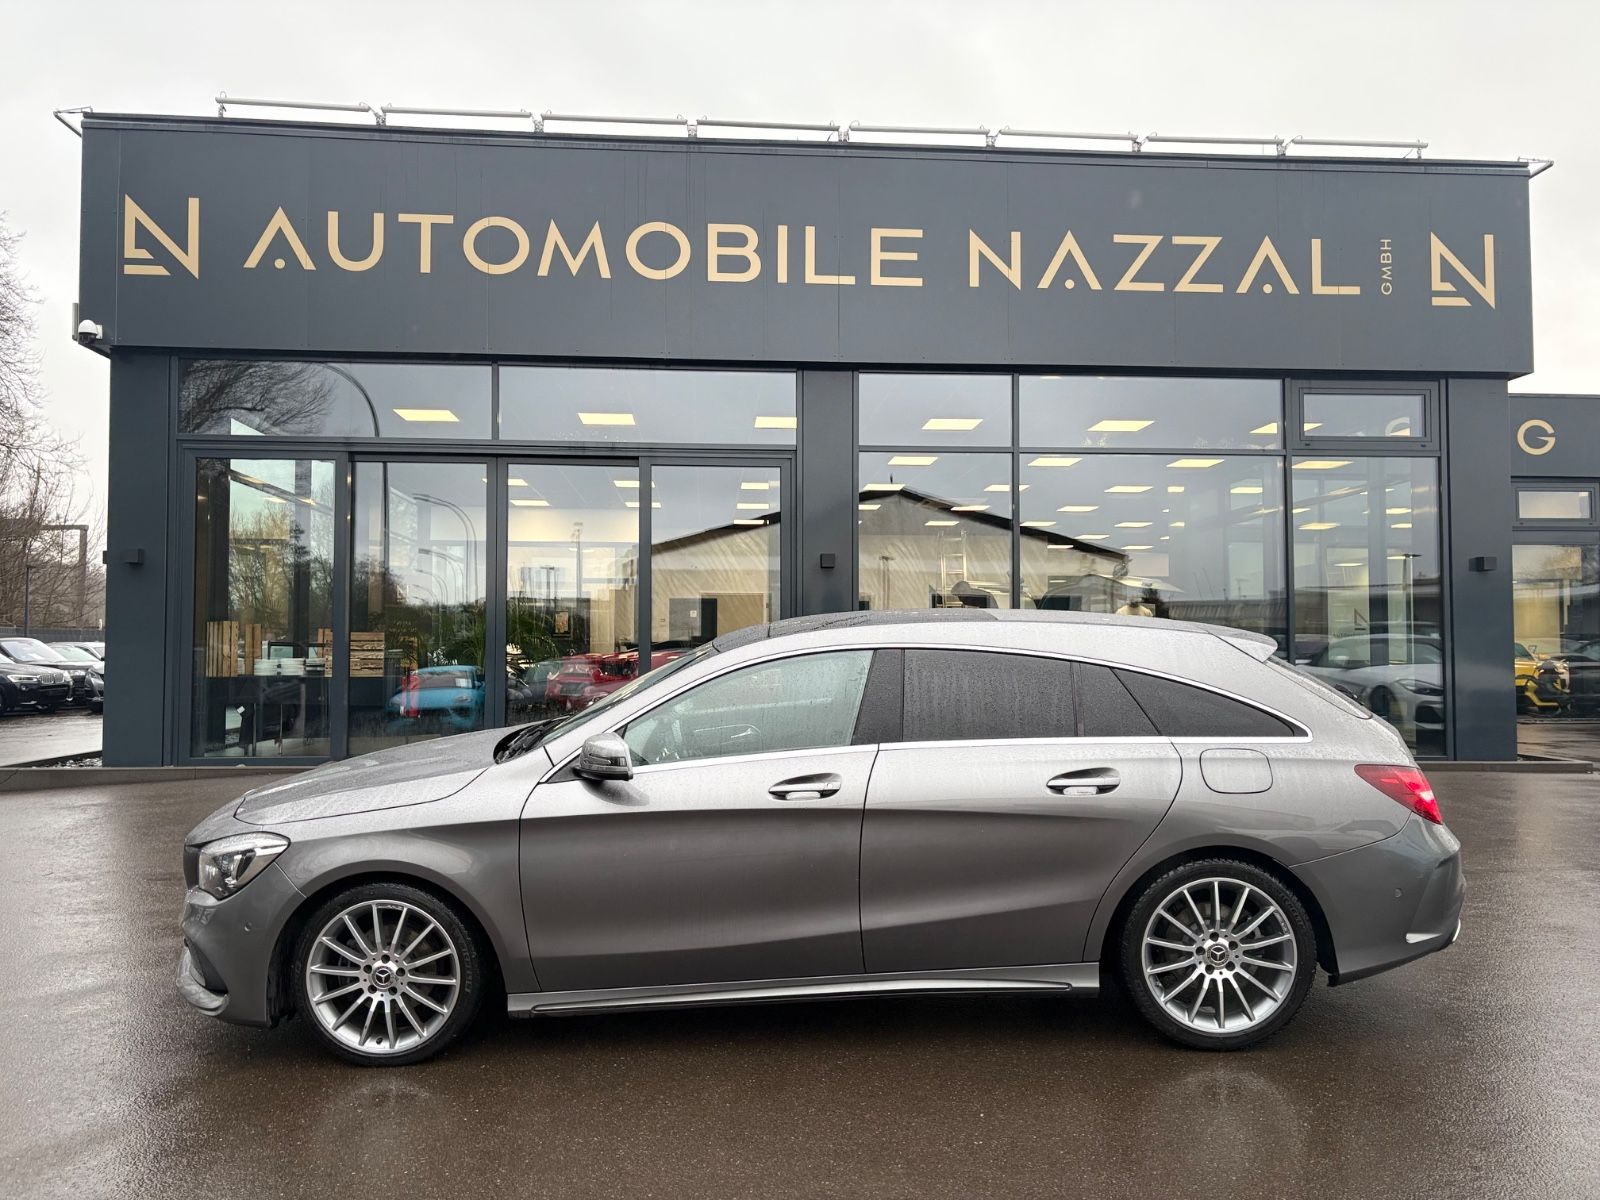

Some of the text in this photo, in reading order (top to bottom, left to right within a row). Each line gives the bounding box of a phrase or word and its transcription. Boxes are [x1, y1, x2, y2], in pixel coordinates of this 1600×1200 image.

[243, 206, 1361, 296] AUTOMOBILE NAZZAL
[1380, 238, 1393, 296] GMBH
[1517, 419, 1556, 456] G
